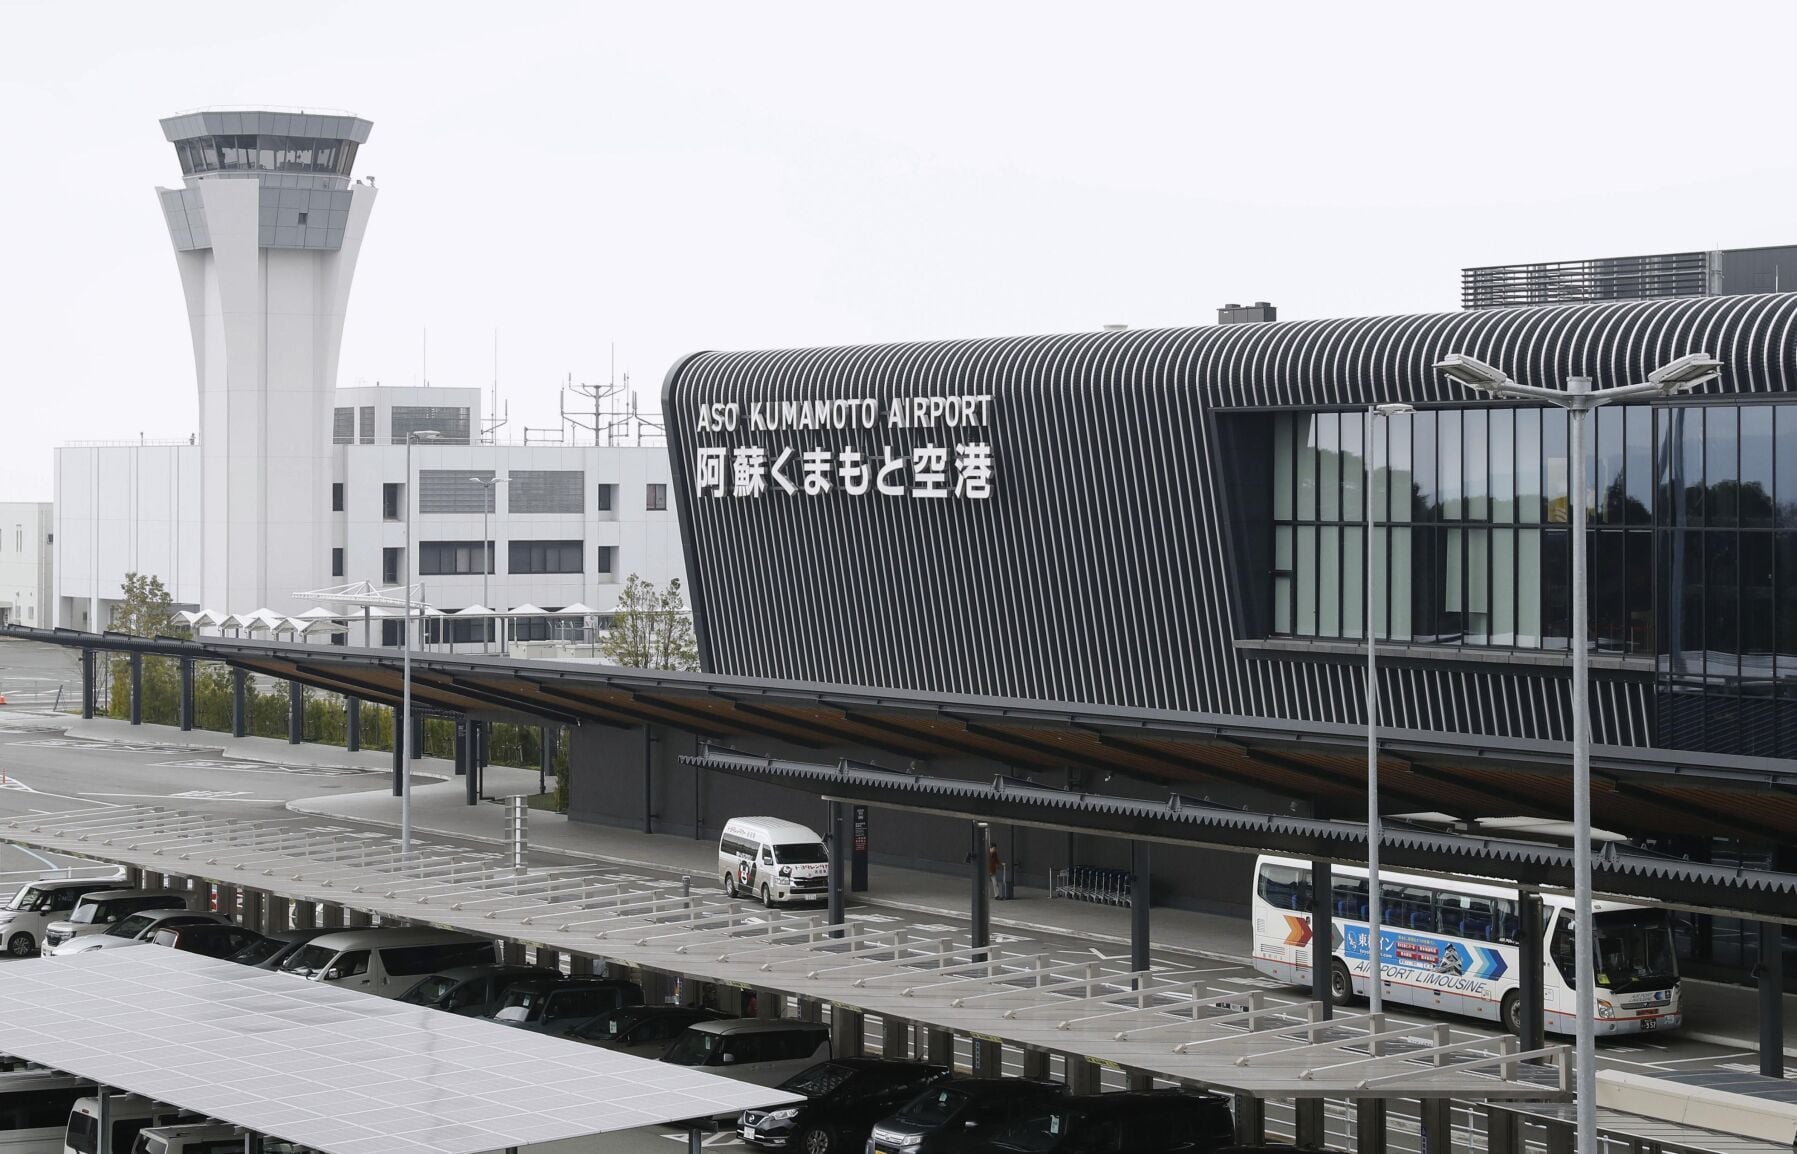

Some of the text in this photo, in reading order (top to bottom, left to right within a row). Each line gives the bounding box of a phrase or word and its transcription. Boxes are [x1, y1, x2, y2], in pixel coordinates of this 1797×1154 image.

[697, 395, 991, 431] ASO KUMAMOTO AIRPORT
[697, 443, 991, 498] 阿蘇くまもと空港
[1358, 933, 1394, 951] 東イン
[1416, 972, 1487, 994] LIMOUSINE
